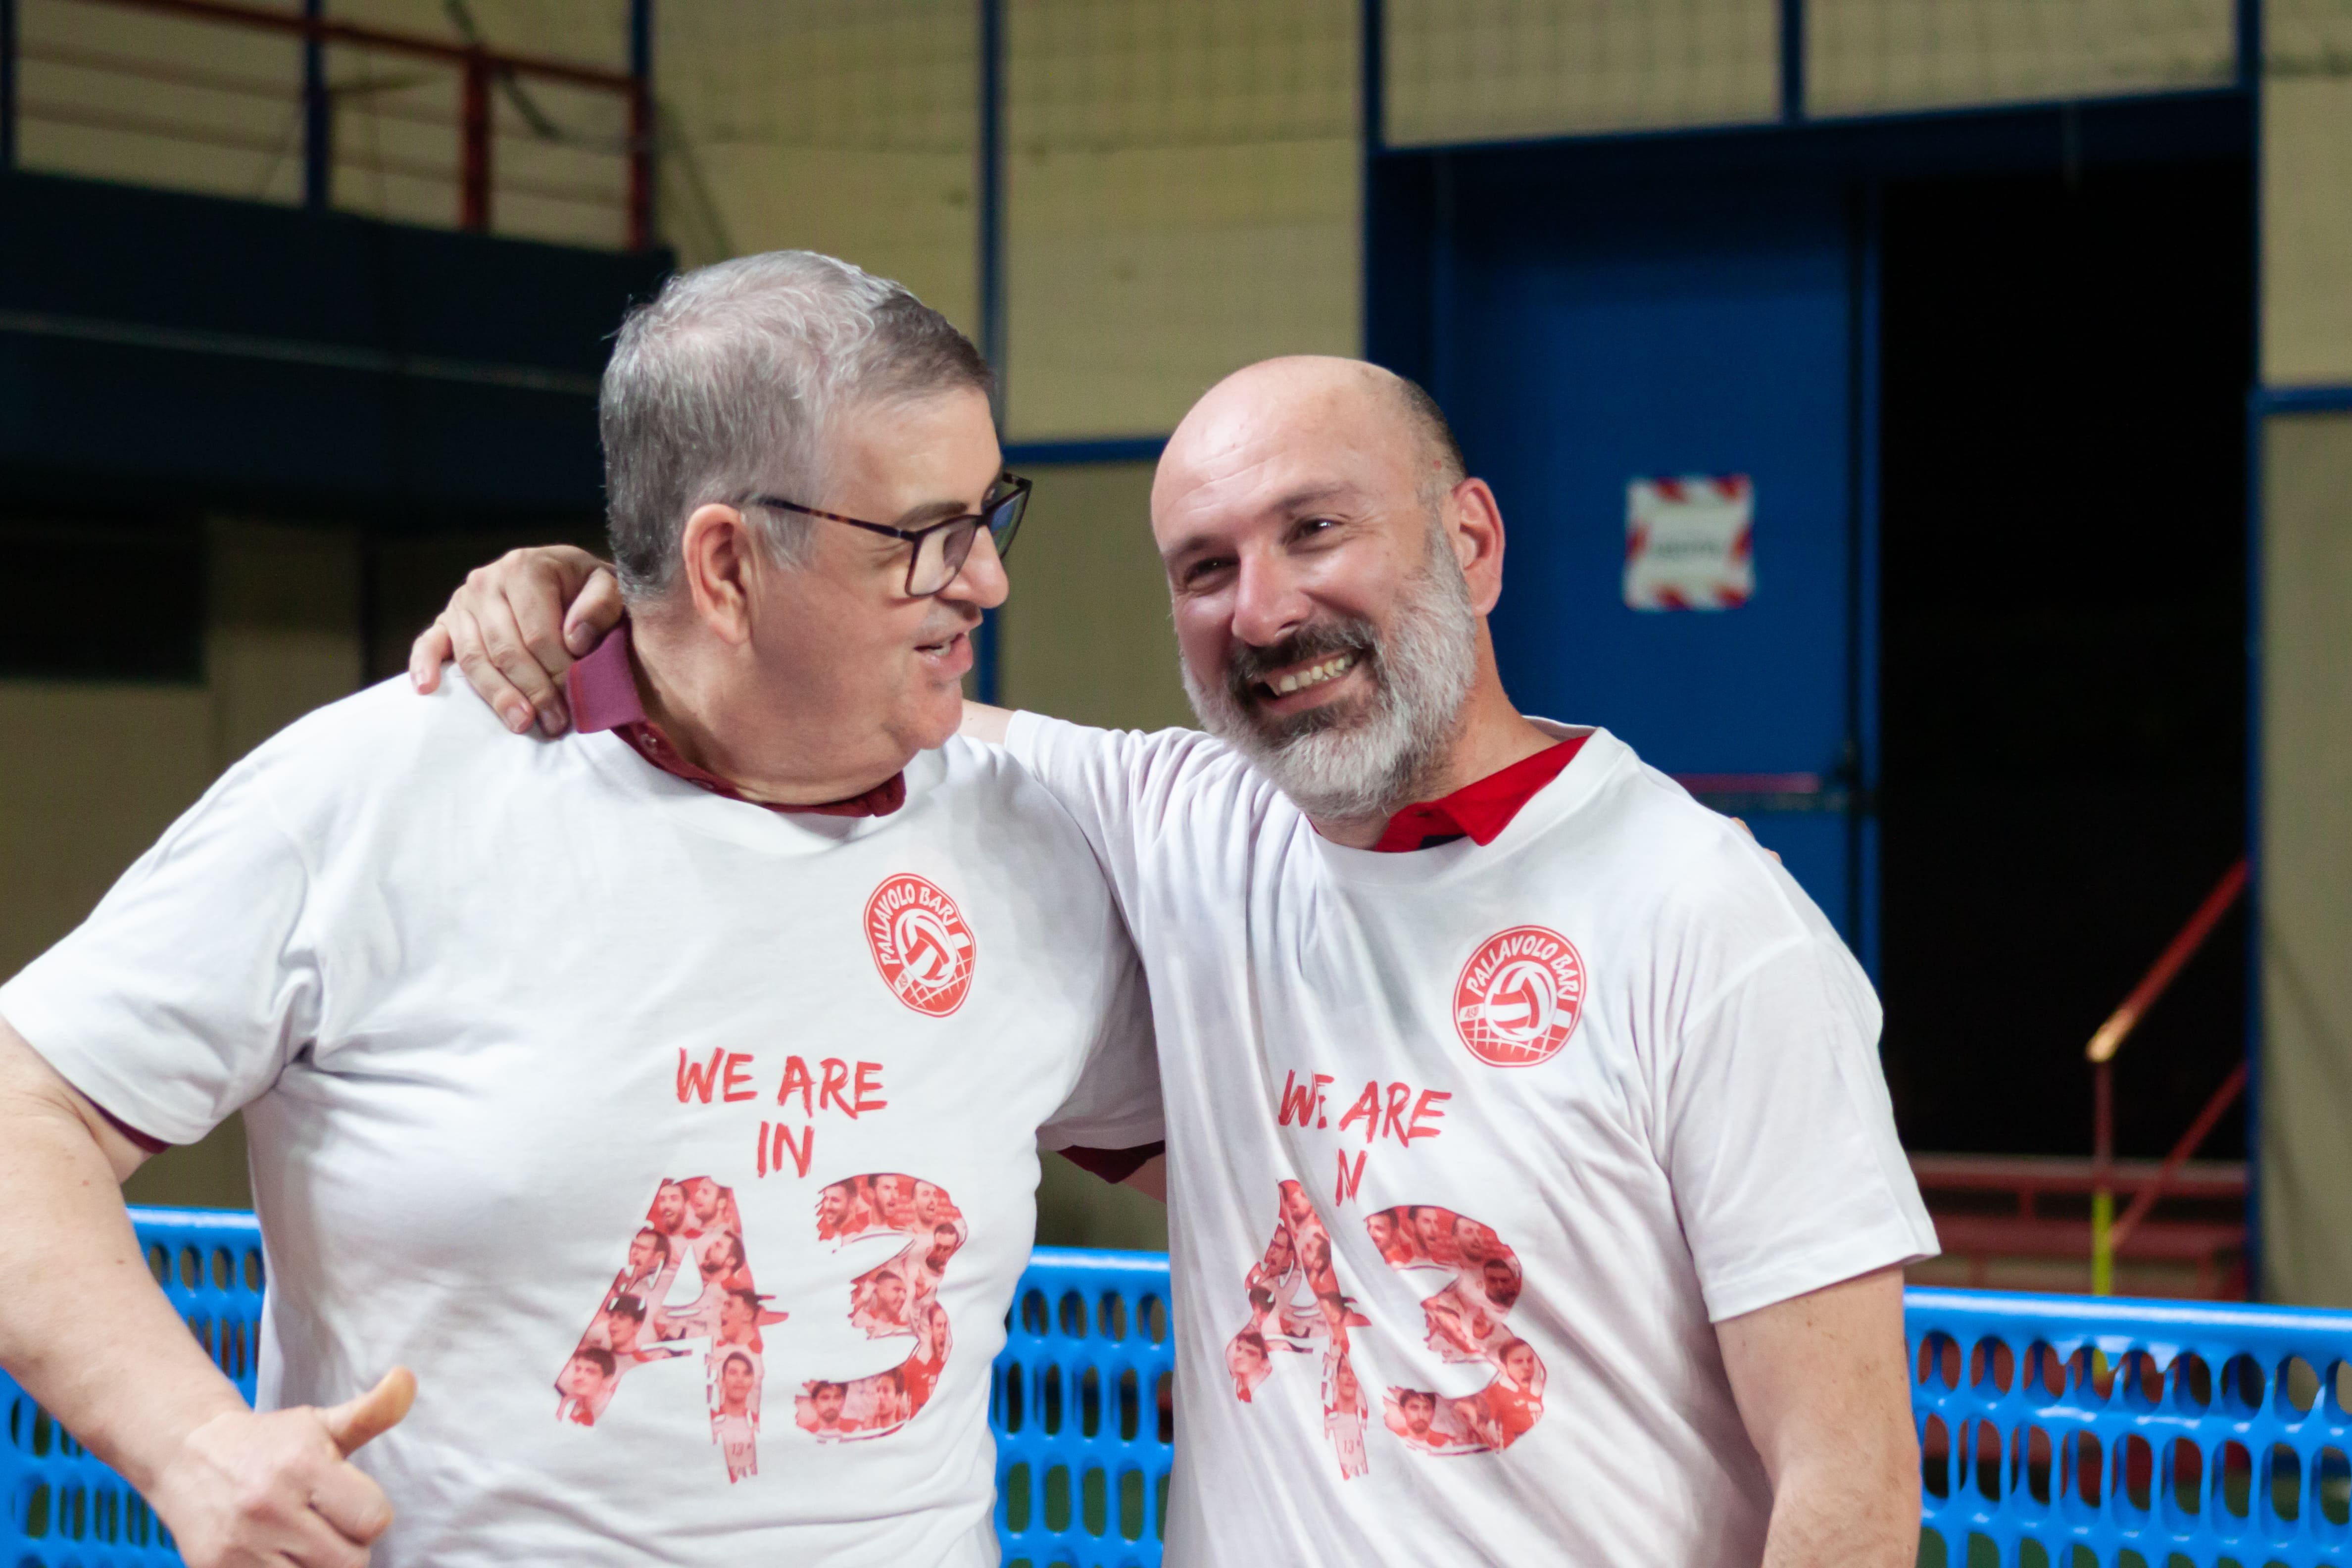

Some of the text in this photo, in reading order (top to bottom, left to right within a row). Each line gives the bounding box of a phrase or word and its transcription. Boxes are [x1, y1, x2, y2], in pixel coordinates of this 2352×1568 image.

[873, 883, 959, 965] PALLAVOLO BARI
[1466, 935, 1579, 1002] PALLAVOLO BARI
[677, 1046, 888, 1120] WE ARE
[1338, 1080, 1453, 1148] ARE
[757, 1121, 815, 1178] IN
